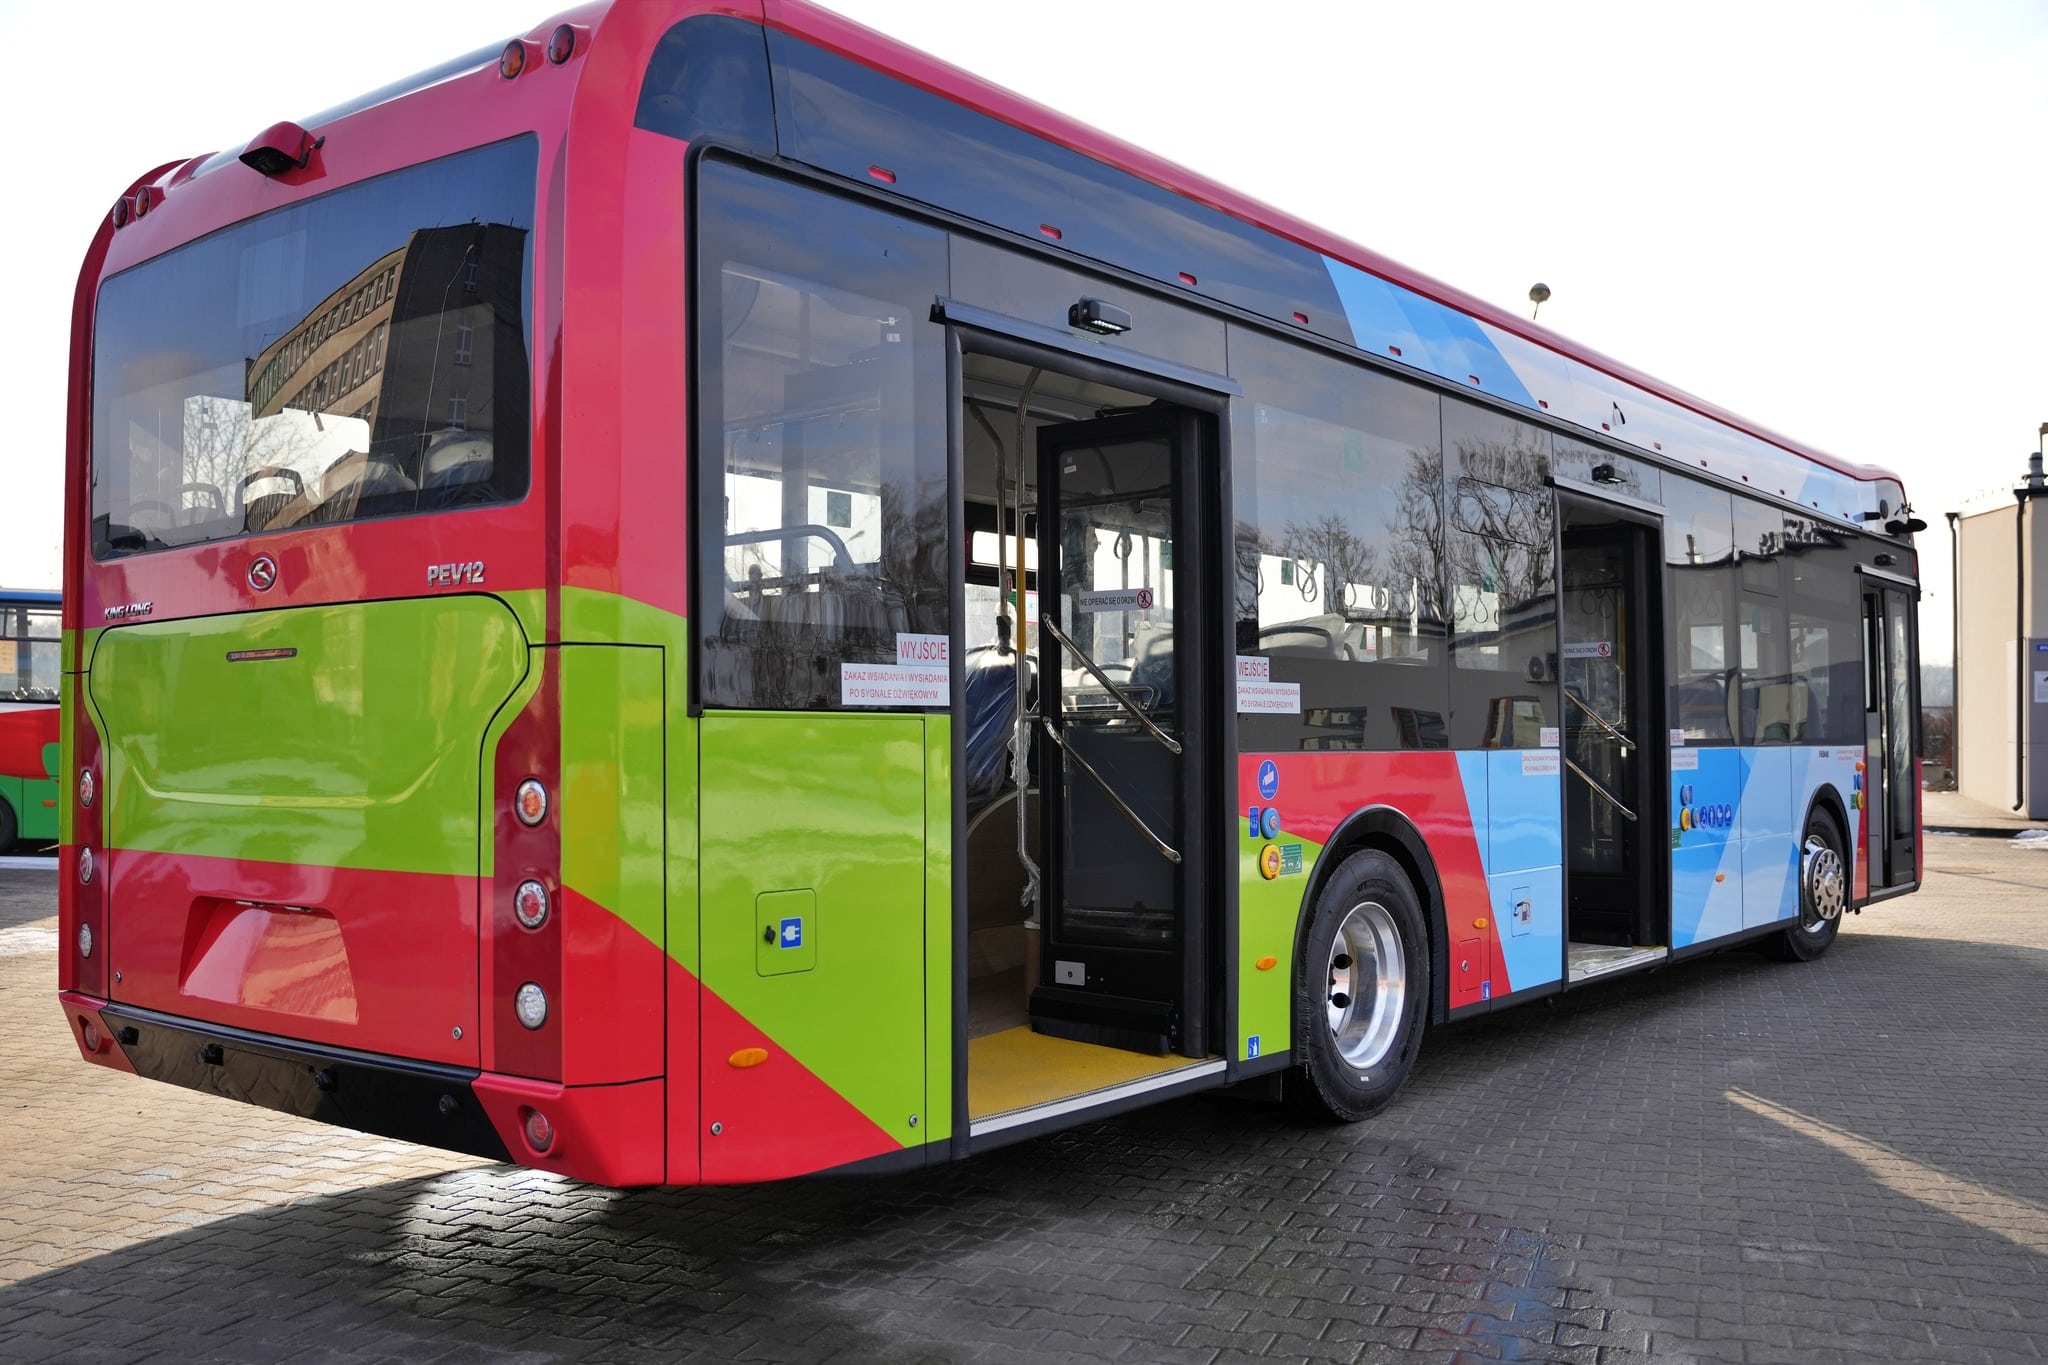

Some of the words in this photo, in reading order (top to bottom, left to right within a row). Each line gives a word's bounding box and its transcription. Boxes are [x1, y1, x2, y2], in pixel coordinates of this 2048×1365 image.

[428, 561, 485, 586] PEV12
[105, 606, 125, 620] KING
[126, 602, 152, 617] LONG
[900, 638, 947, 660] WYJŚCIE
[1238, 659, 1268, 677] WEJŚCIE
[844, 671, 866, 681] ZAKAZ
[867, 672, 905, 682] WSIADANIA
[908, 673, 948, 684] WYSIADANIA
[849, 689, 860, 698] PO
[860, 689, 892, 699] SYGNALE
